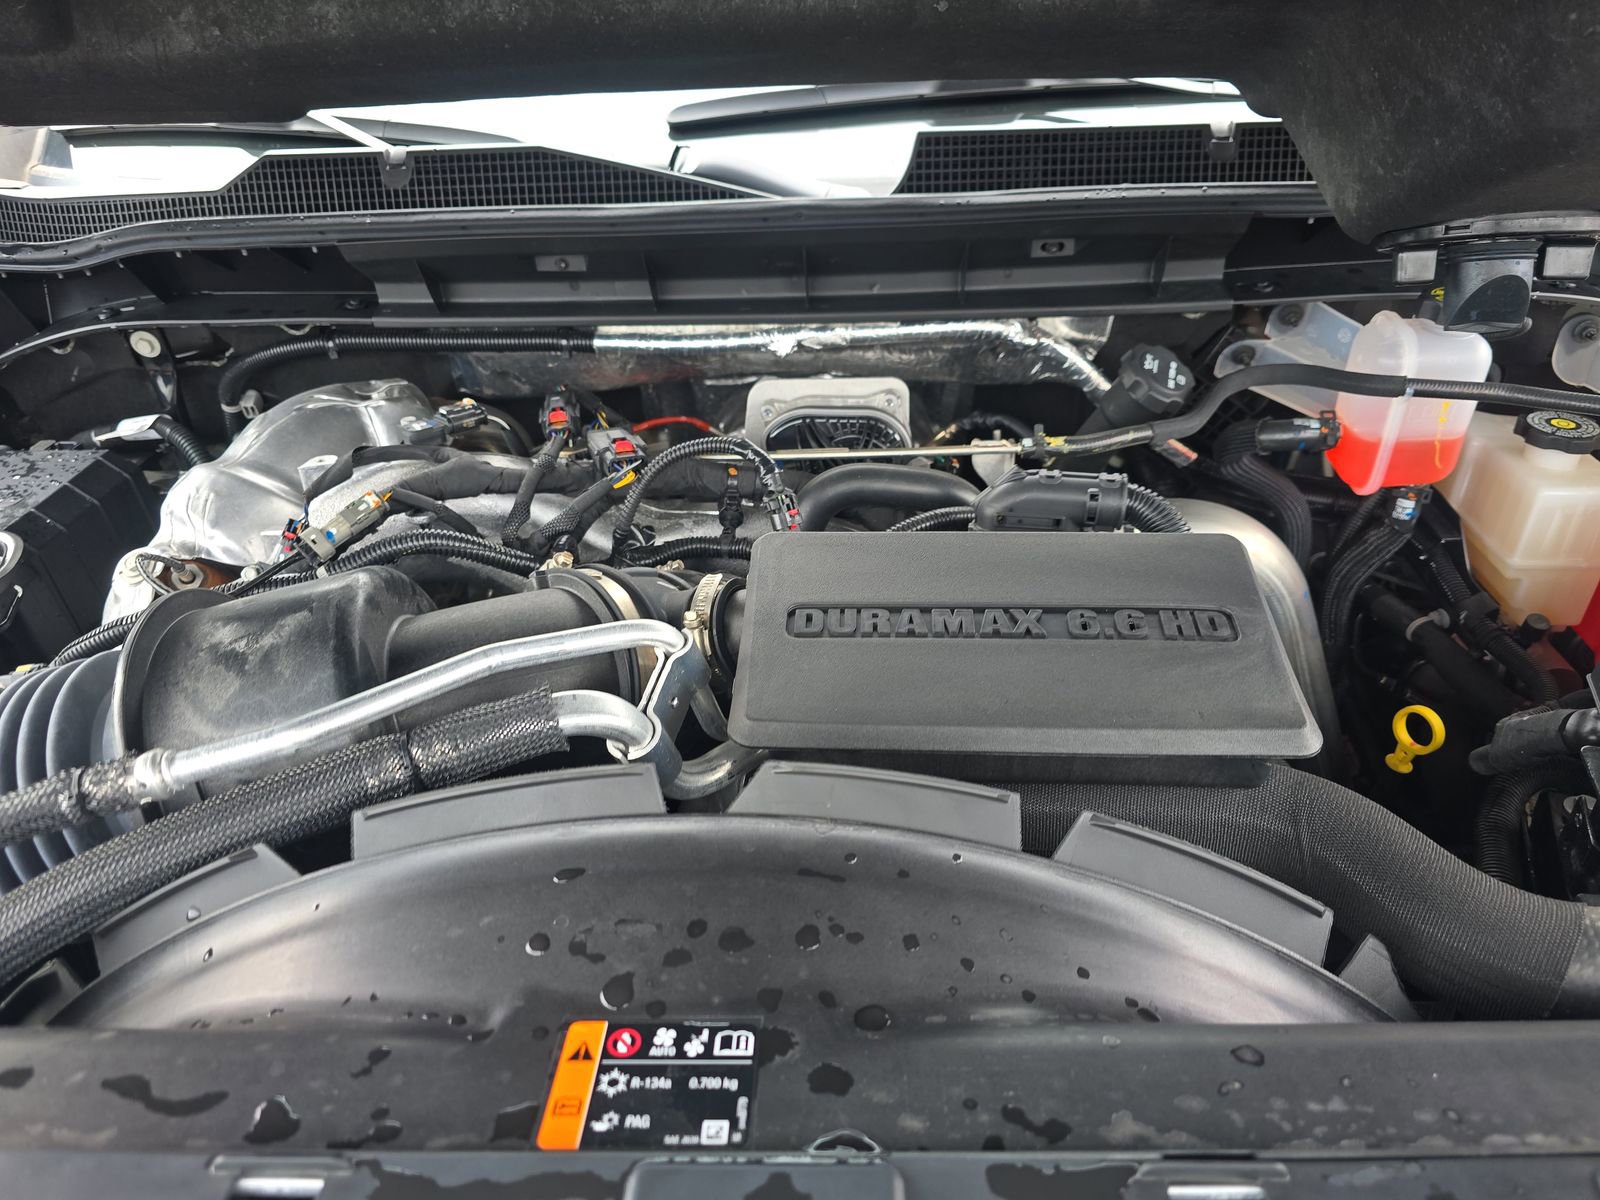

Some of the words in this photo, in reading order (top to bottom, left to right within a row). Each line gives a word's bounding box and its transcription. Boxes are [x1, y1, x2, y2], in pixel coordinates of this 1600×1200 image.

[793, 608, 1047, 639] DURAMAX
[1067, 609, 1149, 640] 6.6
[1158, 609, 1239, 641] HD
[648, 1046, 677, 1057] AUTO
[629, 1076, 672, 1090] R-134a
[722, 1076, 739, 1092] kg
[624, 1114, 651, 1129] PAG
